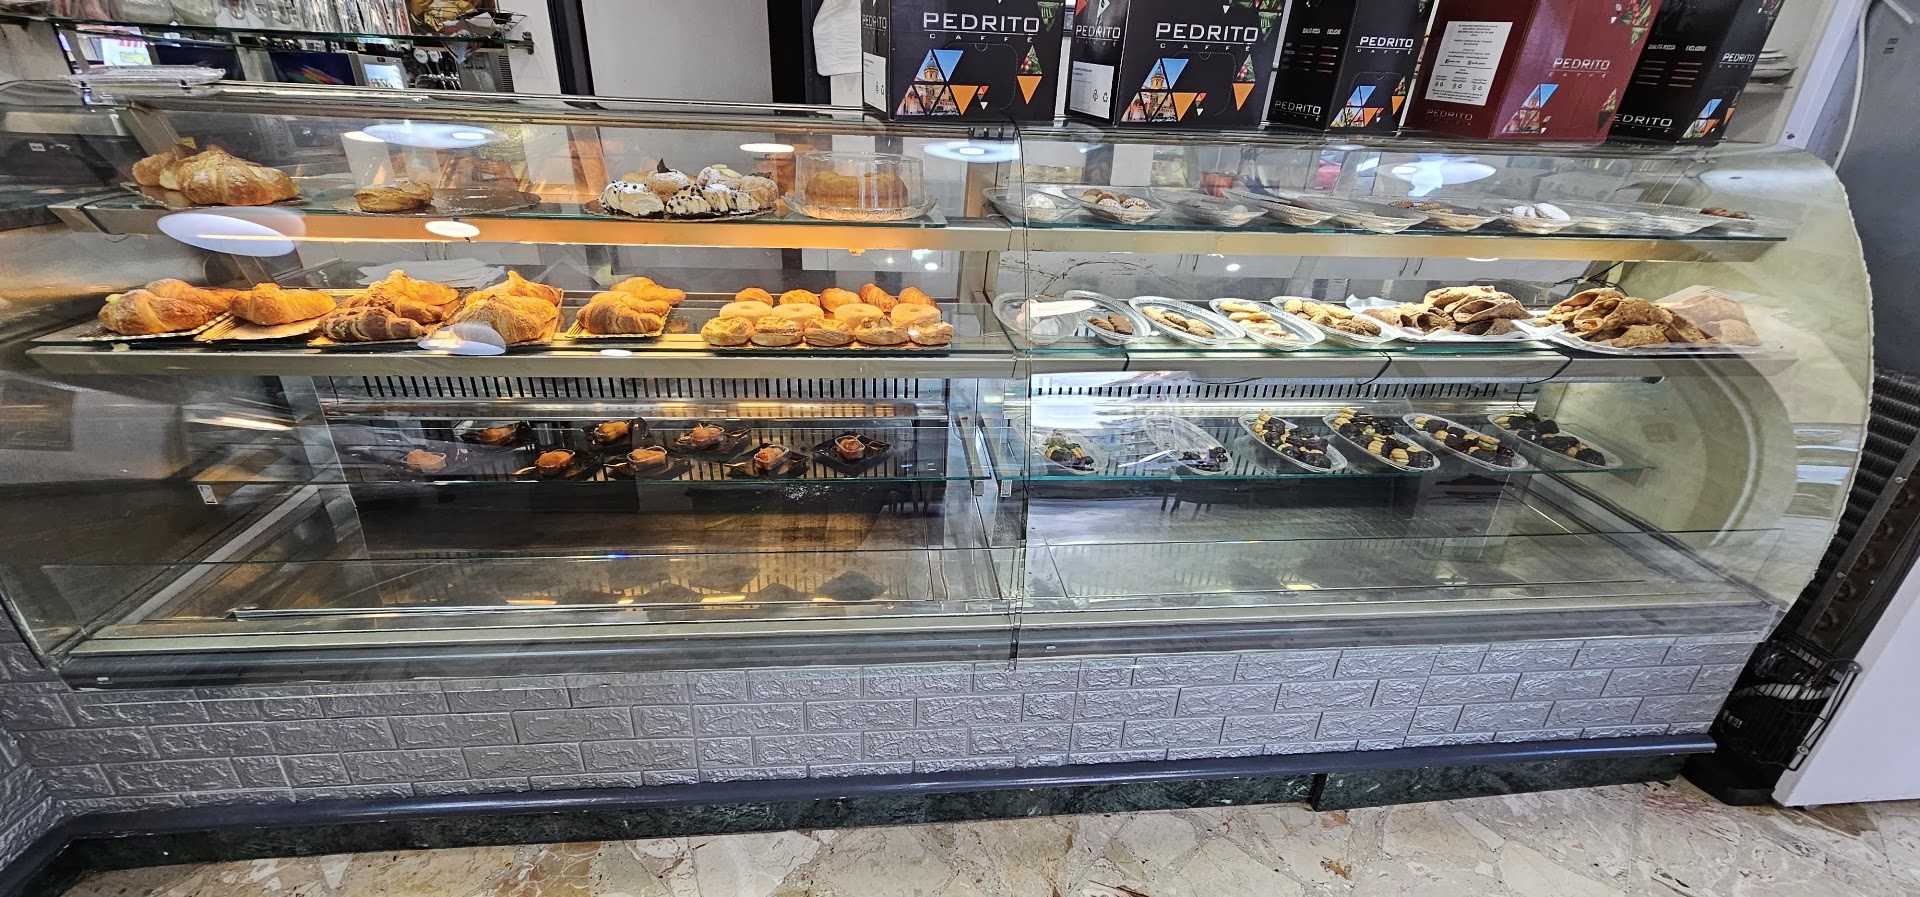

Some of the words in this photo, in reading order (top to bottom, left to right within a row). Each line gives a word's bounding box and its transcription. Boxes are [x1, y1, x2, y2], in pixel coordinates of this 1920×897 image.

[862, 14, 887, 29] PEDRITO
[923, 12, 1040, 33] PEDRITO
[1075, 25, 1121, 39] PEDRITO
[1155, 22, 1259, 42] PEDRITO
[1359, 36, 1414, 48] PEDRITO
[1552, 57, 1611, 70] PEDRITO
[1722, 52, 1756, 63] PEDRITO
[1274, 100, 1322, 115] PEDRITO
[1427, 108, 1473, 121] PEDRITO
[1612, 113, 1673, 127] EDRITO
